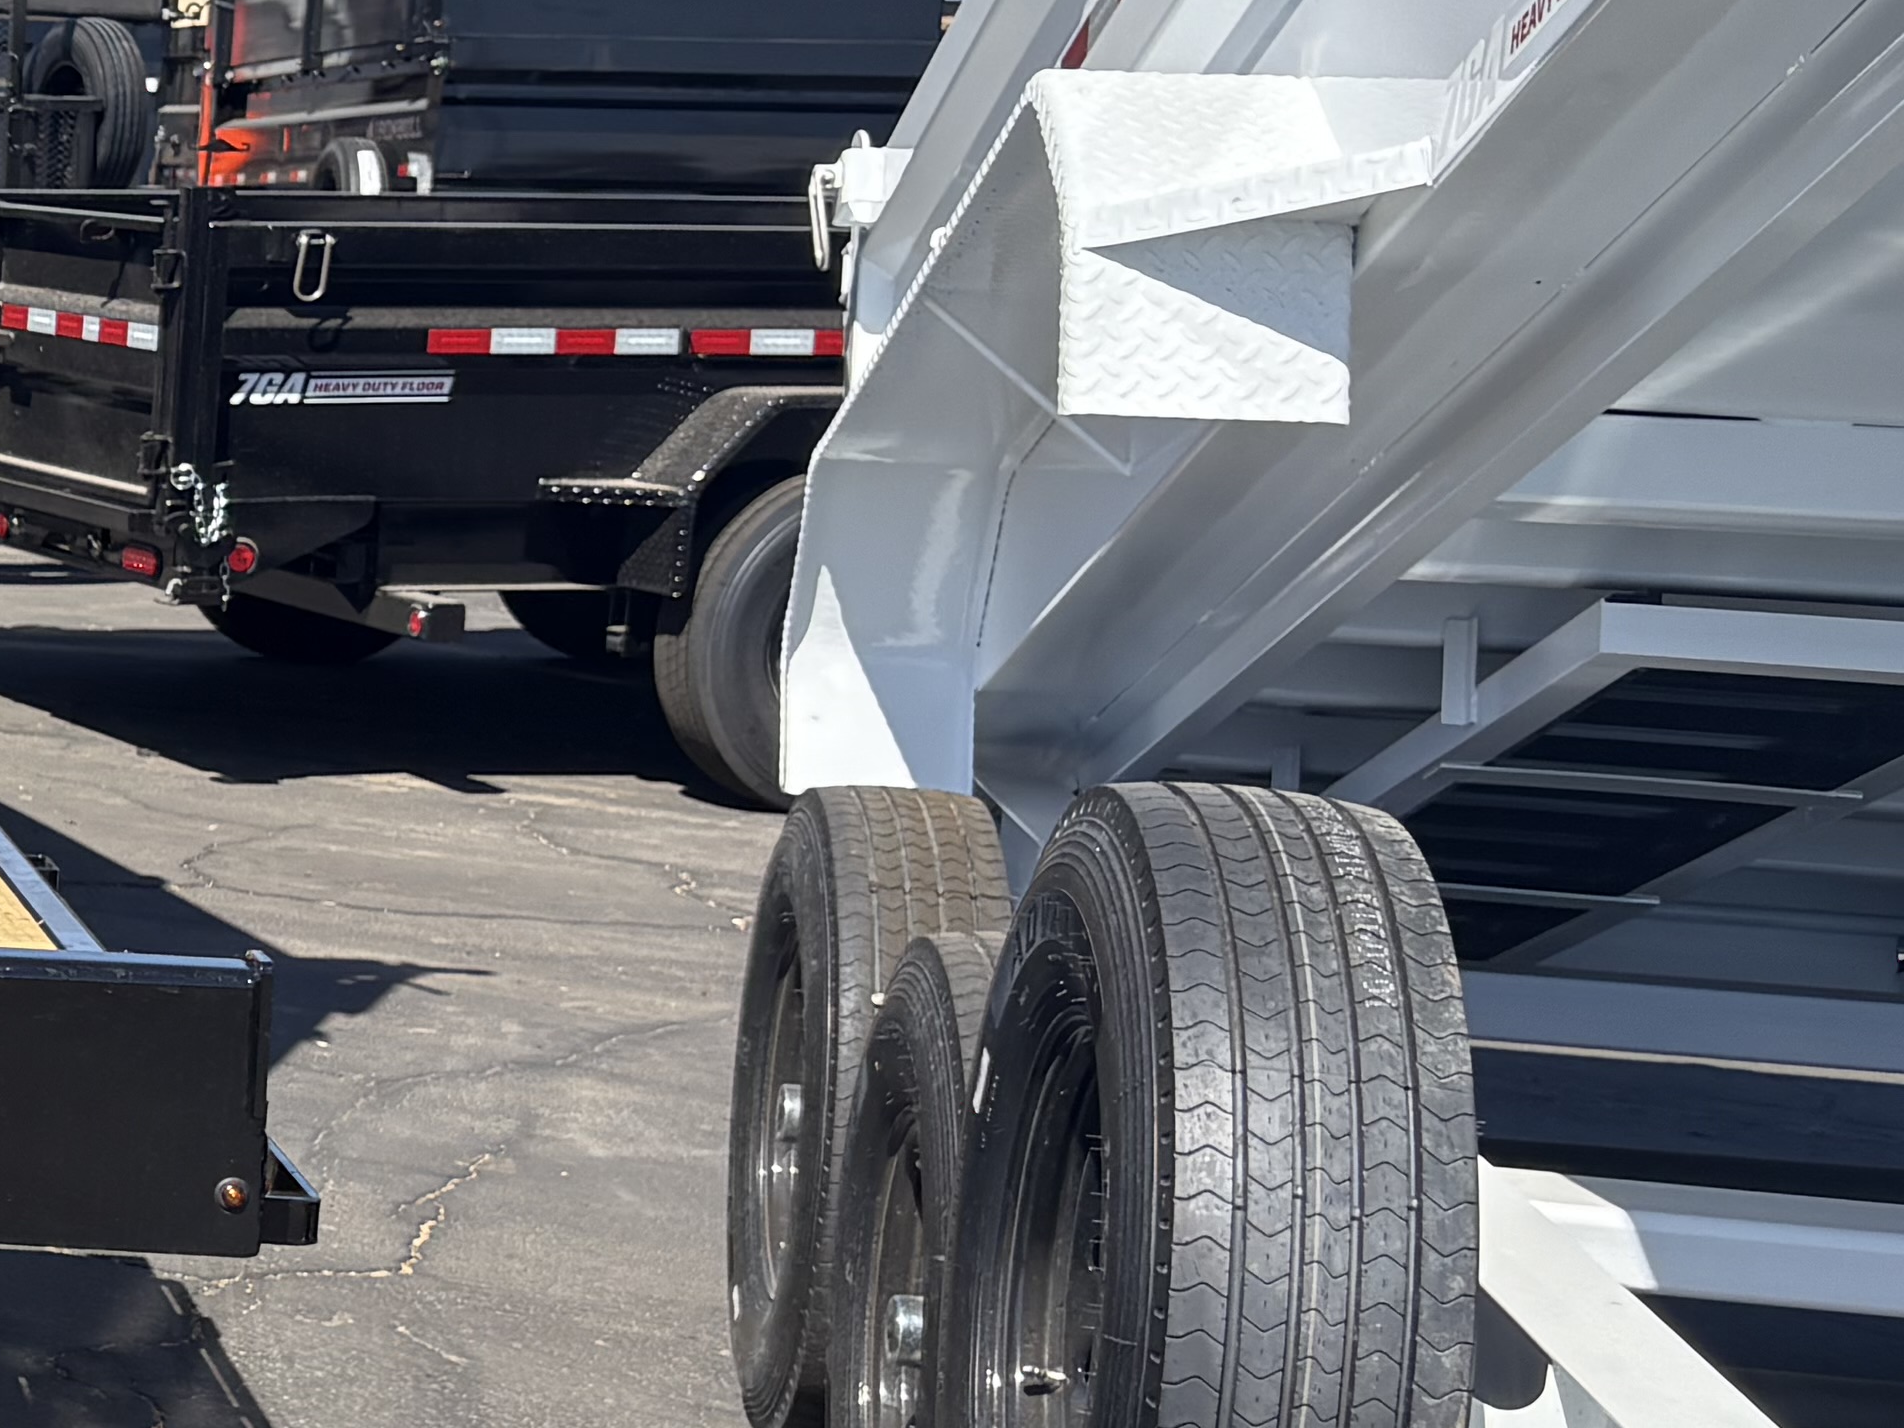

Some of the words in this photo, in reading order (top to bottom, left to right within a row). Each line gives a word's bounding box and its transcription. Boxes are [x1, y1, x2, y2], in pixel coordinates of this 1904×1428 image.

[229, 371, 308, 406] 7GA
[312, 381, 360, 393] HEAVY
[361, 380, 398, 393] DUTY
[400, 380, 445, 392] FLOOR
